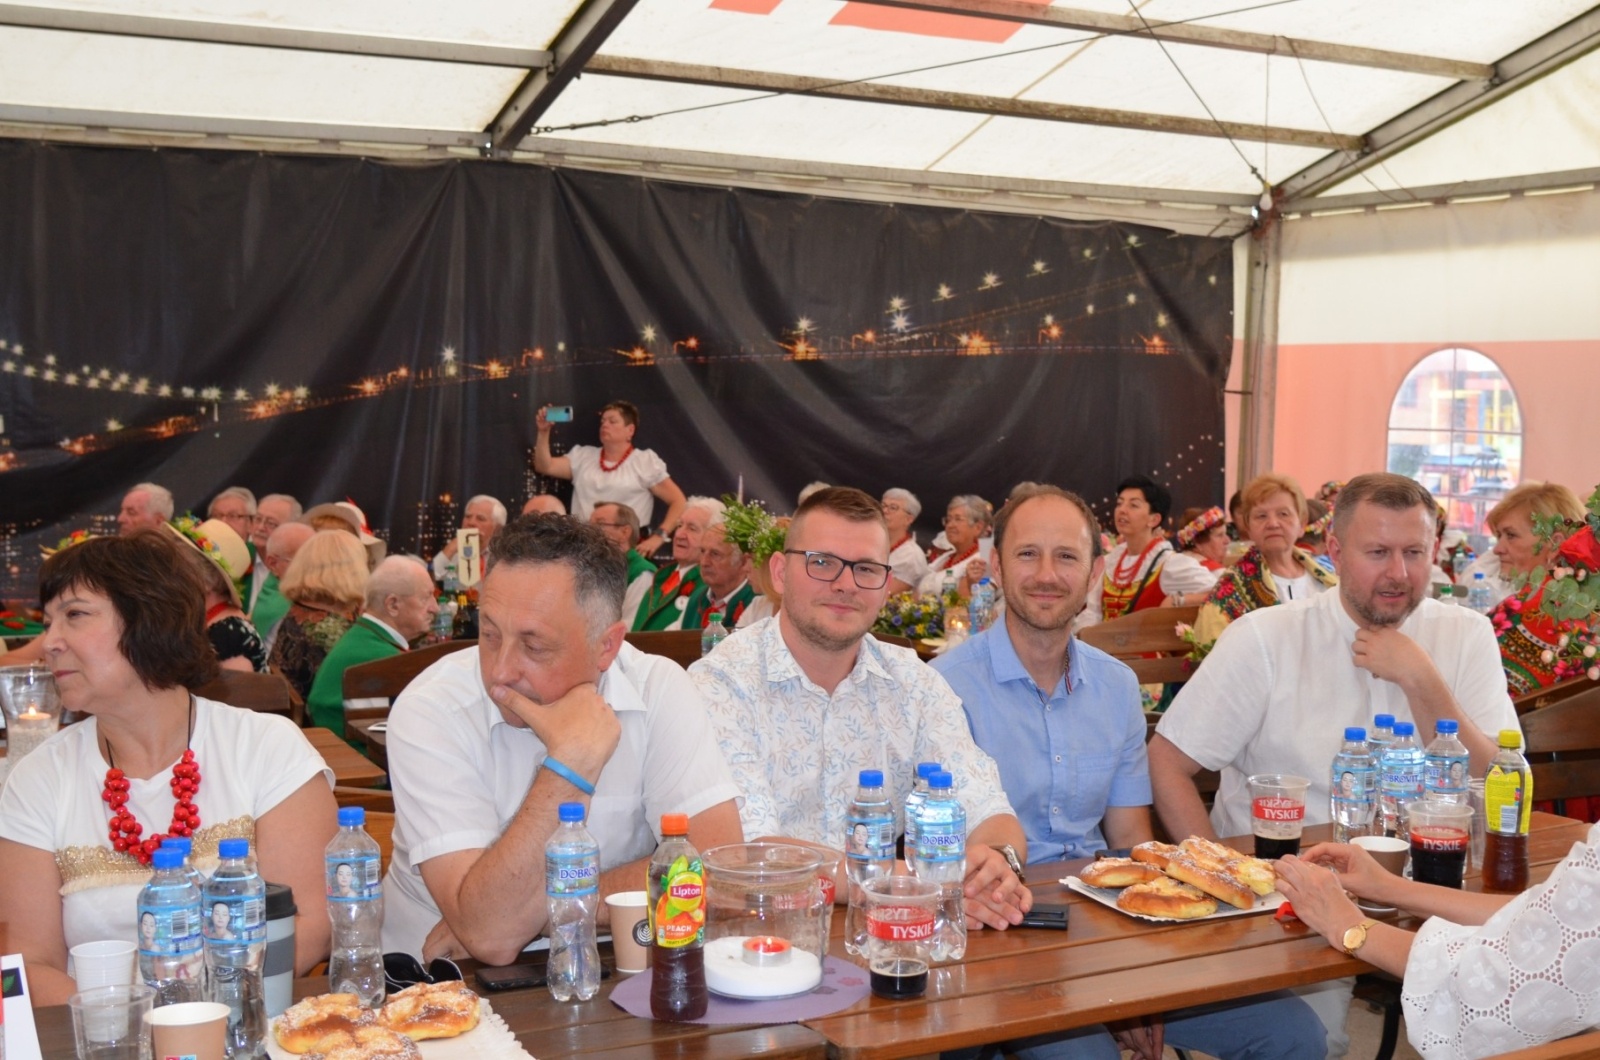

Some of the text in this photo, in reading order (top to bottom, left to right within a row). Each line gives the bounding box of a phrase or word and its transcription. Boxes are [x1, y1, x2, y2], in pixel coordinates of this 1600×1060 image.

[1262, 807, 1300, 820] TYSKIE
[1421, 837, 1461, 851] TYSKIE
[673, 886, 701, 897] Lipton
[666, 924, 692, 932] PEACH
[889, 921, 933, 939] TYSKIE
